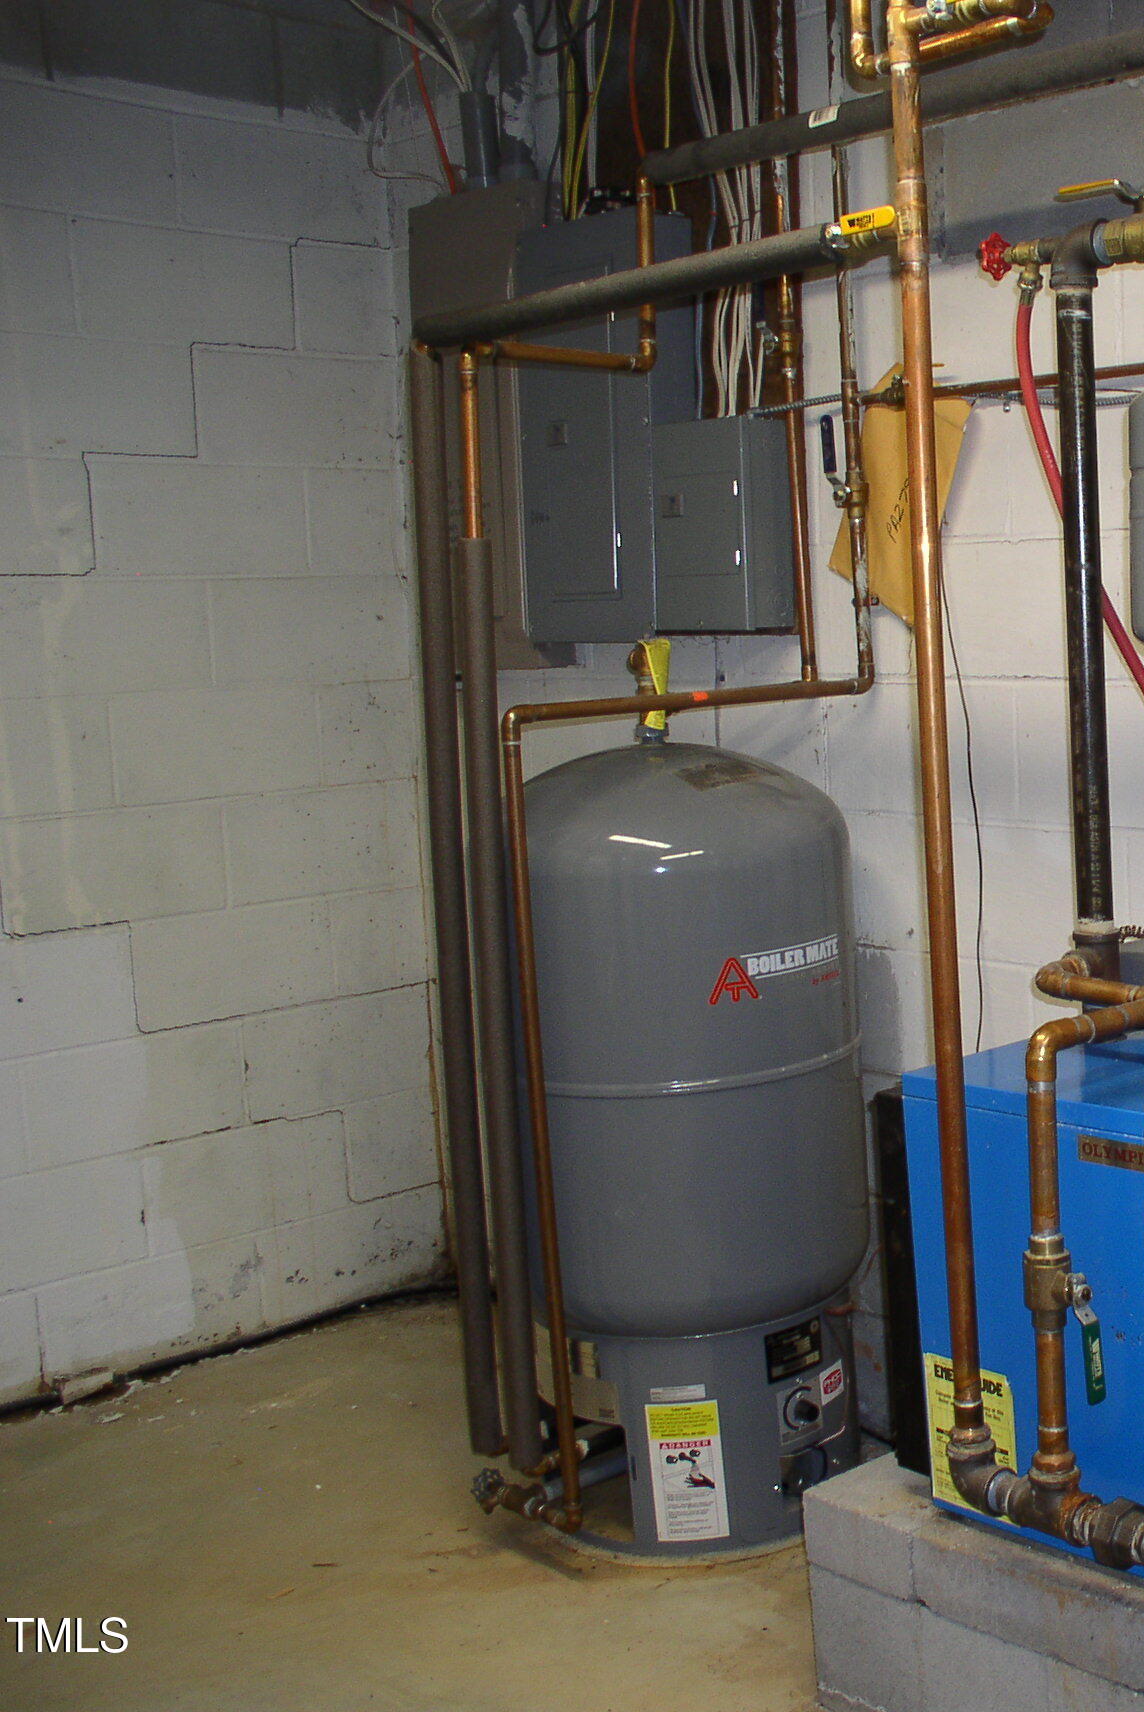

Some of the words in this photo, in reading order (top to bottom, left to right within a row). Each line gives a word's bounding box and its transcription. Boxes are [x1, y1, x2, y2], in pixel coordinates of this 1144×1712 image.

[747, 949, 806, 976] BOILER
[805, 938, 839, 963] MATE
[669, 1440, 710, 1449] DANGER
